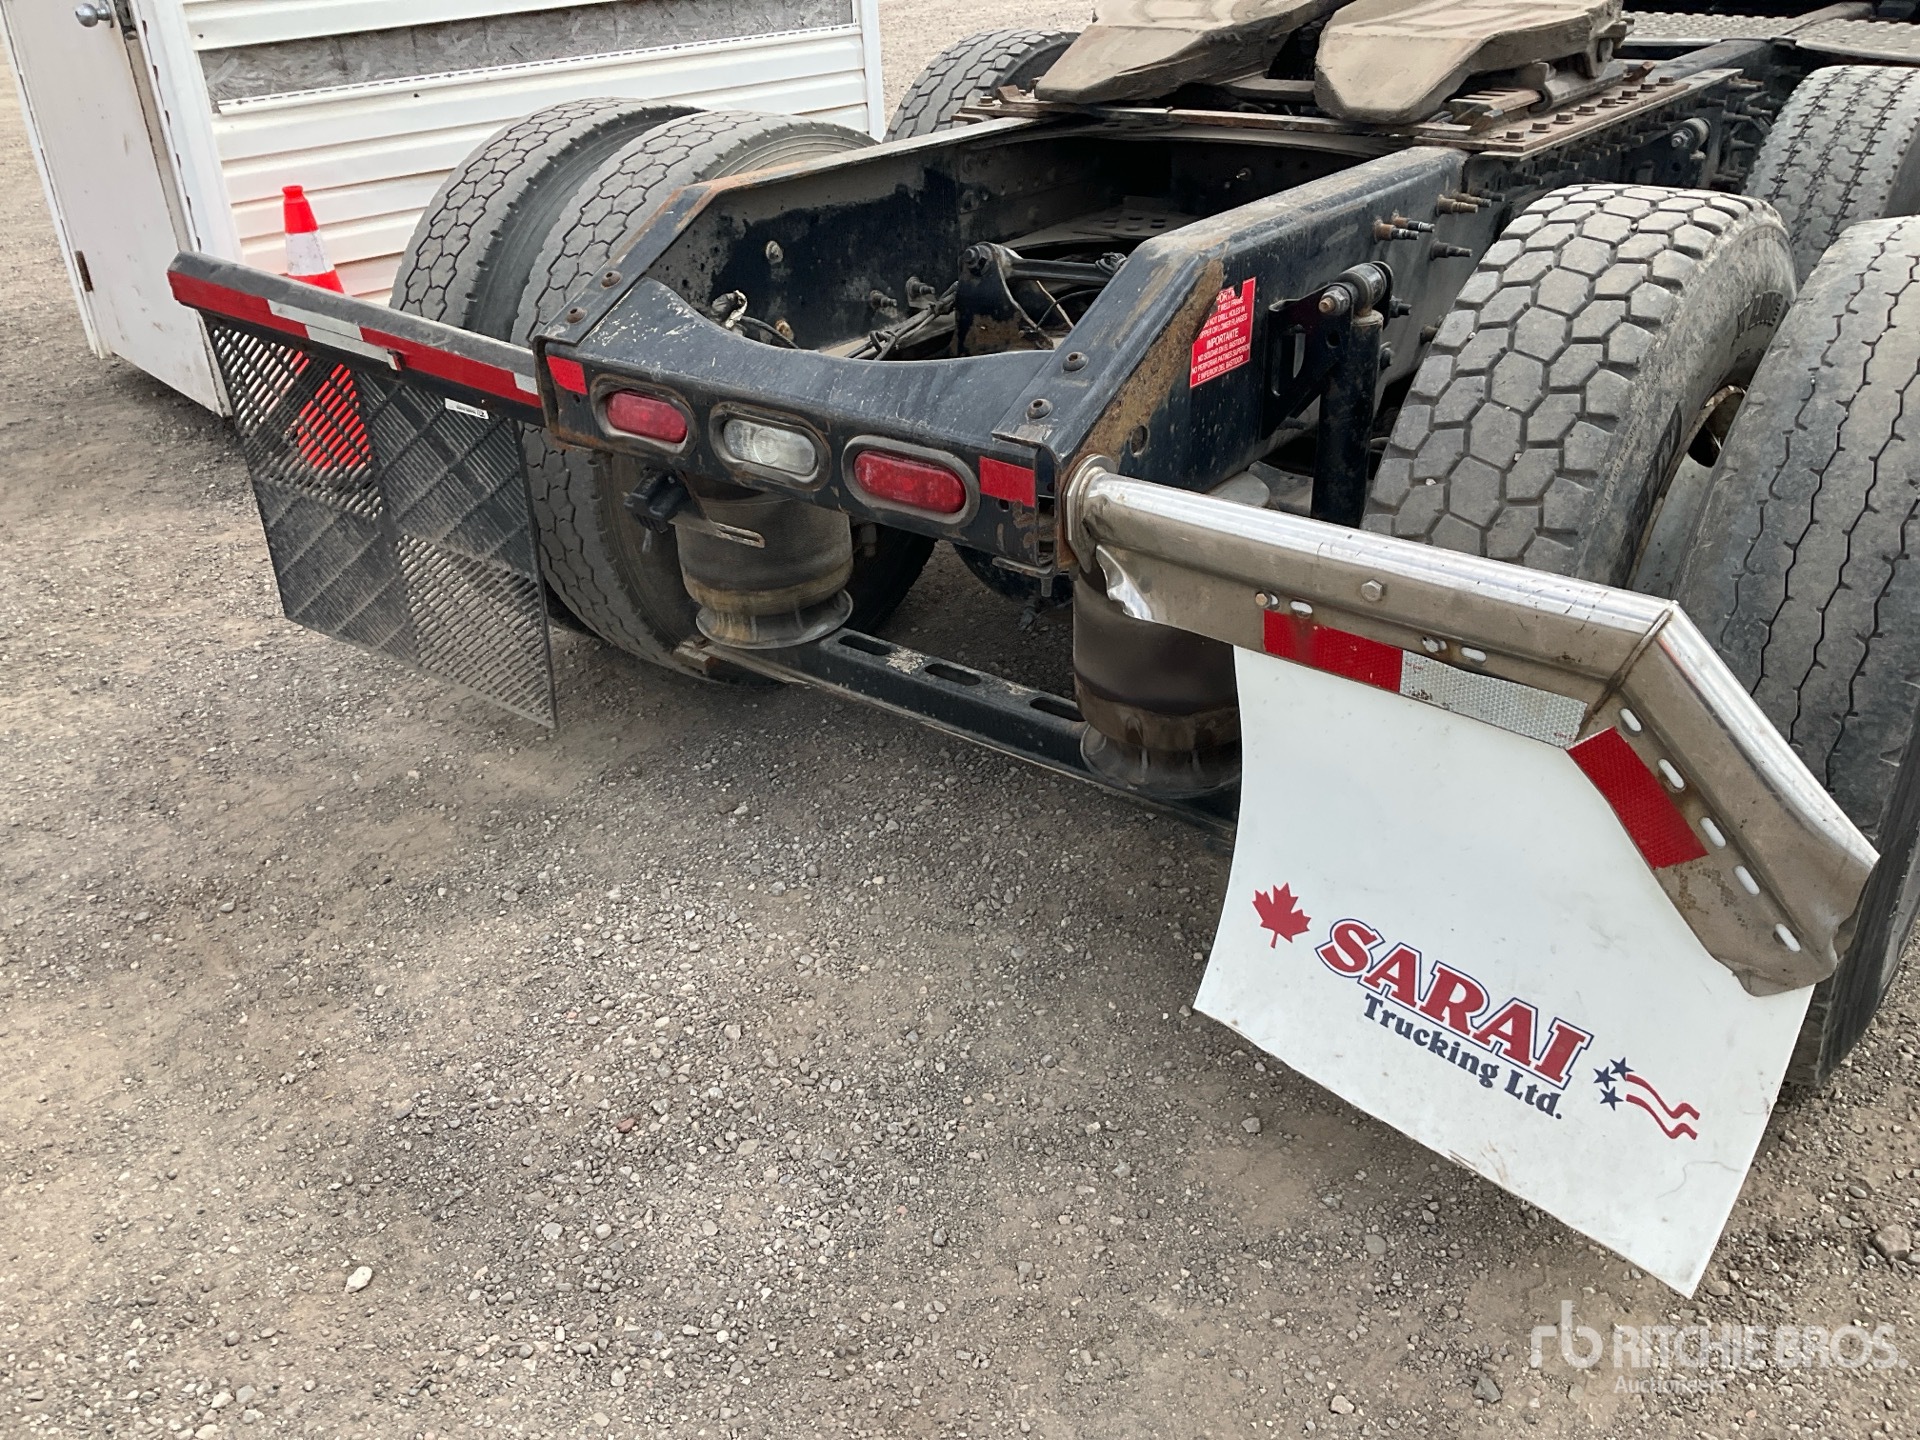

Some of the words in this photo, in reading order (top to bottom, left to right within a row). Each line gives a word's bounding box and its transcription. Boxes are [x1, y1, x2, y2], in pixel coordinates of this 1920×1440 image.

[1217, 312, 1228, 321] DRILL
[1228, 307, 1240, 316] HOLES
[1218, 320, 1230, 330] LOWER
[1230, 312, 1248, 325] FLANGES
[1197, 354, 1203, 362] NO
[1203, 348, 1218, 359] SOLDAR
[1228, 335, 1246, 347] BASTIDOR
[1206, 327, 1239, 349] IMPORTANTE
[1191, 366, 1197, 374] NO
[1197, 358, 1217, 370] PERFORAR
[1200, 367, 1218, 378] INFERIOR
[1225, 355, 1243, 367] BASTIDOR
[1315, 918, 1594, 1090] SARAI
[1363, 993, 1499, 1088] Trucking
[1503, 1069, 1564, 1120] Ltd.
